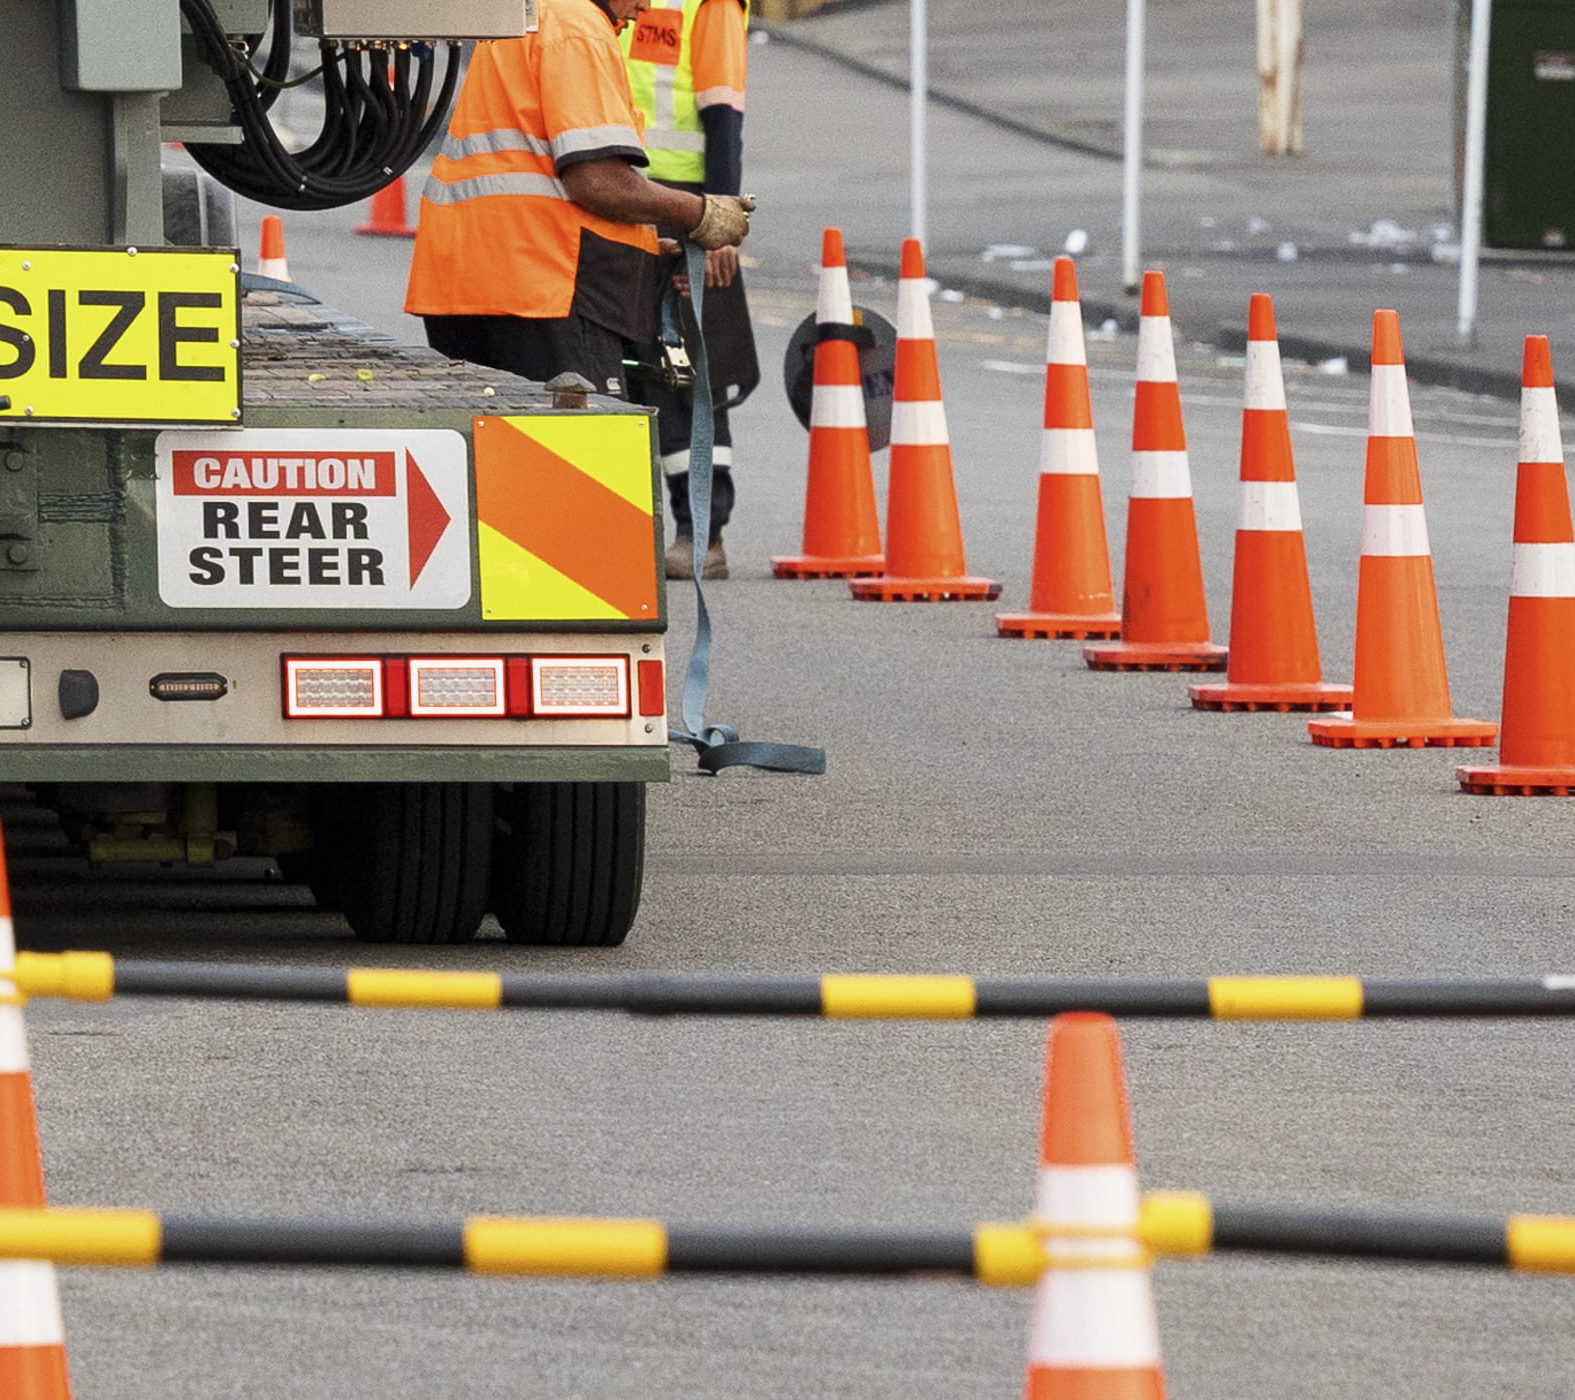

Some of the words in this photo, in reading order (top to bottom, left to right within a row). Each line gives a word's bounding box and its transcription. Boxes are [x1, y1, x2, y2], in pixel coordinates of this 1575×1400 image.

[636, 23, 677, 47] STMS
[193, 457, 376, 490] CAUTION
[202, 501, 370, 540] REAR
[188, 546, 386, 586] STEER
